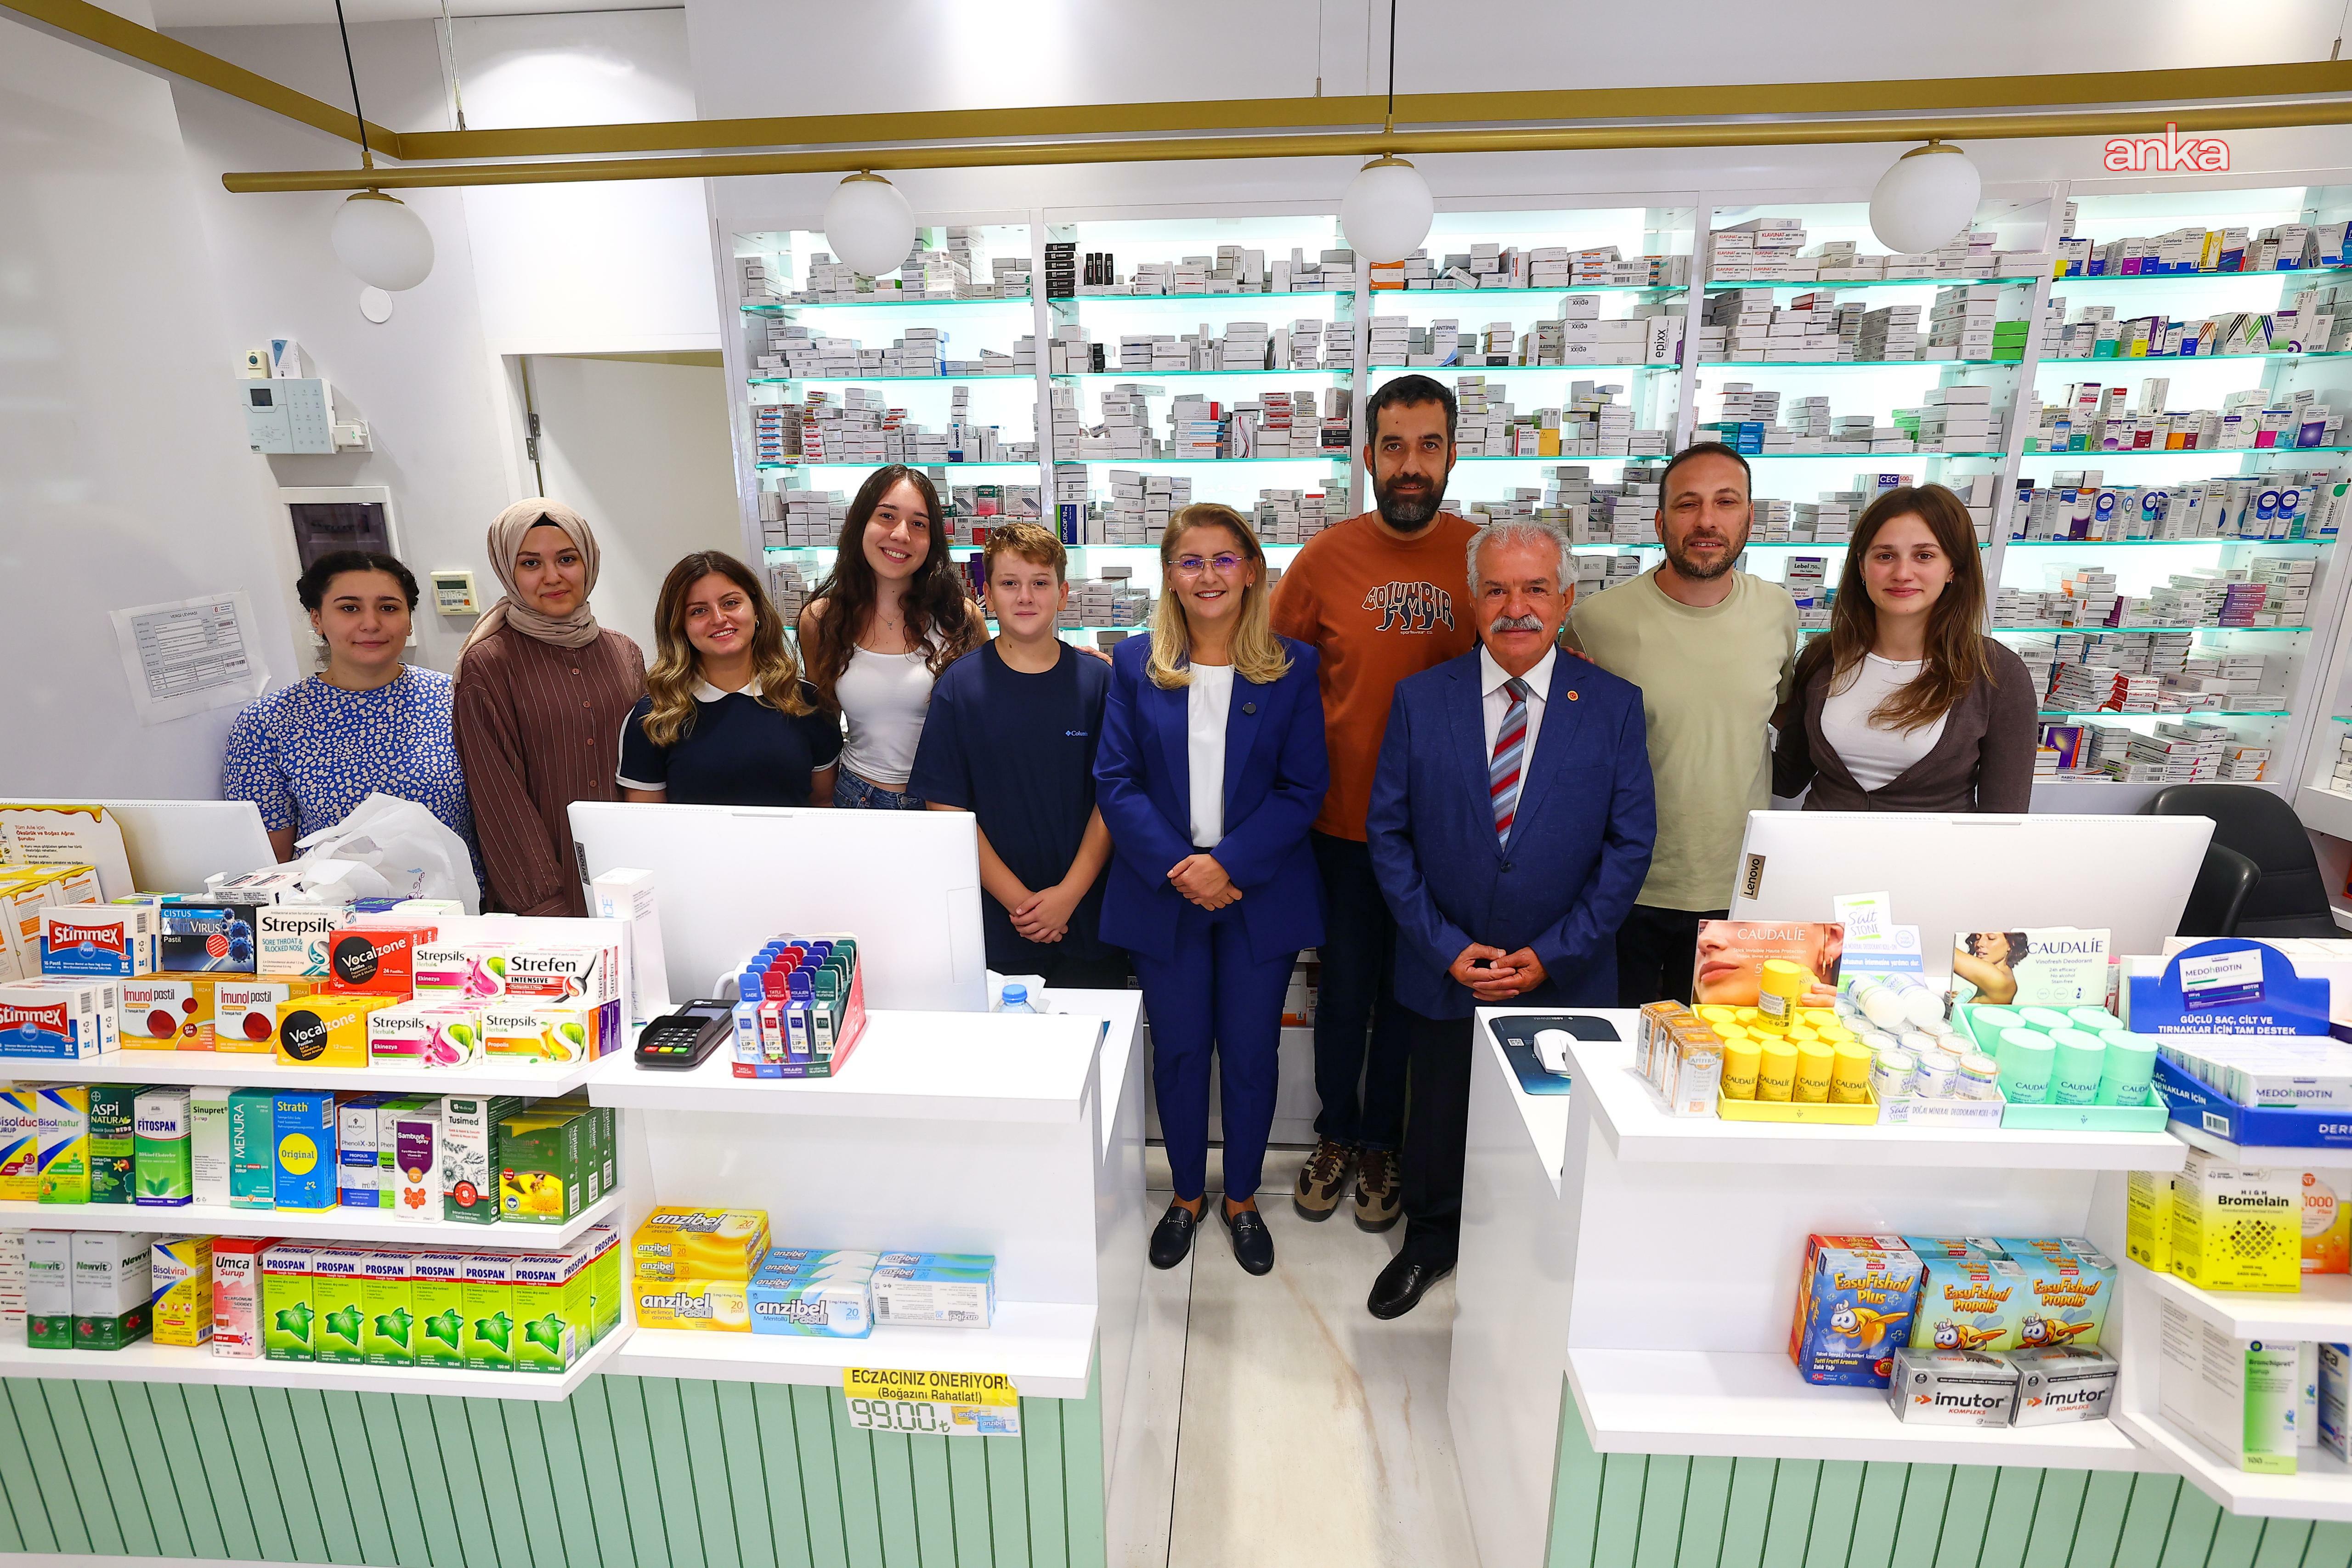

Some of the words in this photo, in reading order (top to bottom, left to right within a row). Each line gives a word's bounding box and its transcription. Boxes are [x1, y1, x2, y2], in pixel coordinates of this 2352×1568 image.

[1654, 329, 1666, 357] epixx
[2324, 502, 2335, 526] Nazoster
[1362, 581, 1454, 631] COLUMBIA
[1744, 858, 1760, 897] Lenovo
[262, 917, 335, 936] Strepsils
[1851, 924, 1879, 936] STONE
[55, 926, 119, 945] Stimmex
[417, 951, 464, 962] Strepsils
[511, 957, 576, 972] Strefen
[154, 989, 175, 1002] pastil
[373, 1017, 424, 1030] Strepsils
[487, 1015, 537, 1028] Strepsils
[2180, 1016, 2212, 1025] GÜÇLÜ
[2215, 1016, 2236, 1025] SAÇ,
[2239, 1016, 2258, 1025] CİLT
[2260, 1016, 2273, 1025] VE
[2214, 1026, 2232, 1035] İÇİN
[2257, 1026, 2295, 1035] DESTEK
[277, 1102, 308, 1112] Strath
[449, 1116, 479, 1126] Tusimed
[234, 1104, 244, 1158] MENURA
[282, 1150, 314, 1159] Original
[2218, 1195, 2289, 1207] Bromelain
[216, 1256, 249, 1269] Umca
[267, 1260, 305, 1269] PROSPAN
[317, 1262, 354, 1272] PROSPAN
[153, 1265, 187, 1276] Bisolviral
[366, 1265, 403, 1274] PROSPAN
[416, 1266, 454, 1275] PROSPAN
[466, 1268, 504, 1278] PROSPAN
[1834, 1272, 1914, 1292] EasyFishoil
[2034, 1279, 2102, 1296] EasyFishoil
[1857, 1291, 1886, 1304] Plus
[1944, 1284, 2013, 1301] EasyFishoil
[640, 1293, 711, 1308] anzibel
[1953, 1299, 1998, 1314] Propolis
[2041, 1294, 2087, 1307] Propolis
[755, 1300, 826, 1315] anzibel
[852, 1370, 925, 1385] ECZACINIZ
[929, 1370, 1008, 1389] ÖNERİYOR!
[878, 1388, 927, 1399] (Boğazını
[932, 1390, 982, 1404] Rahatlat!)
[1935, 1392, 2005, 1409] imutor
[2045, 1389, 2105, 1406] imutor
